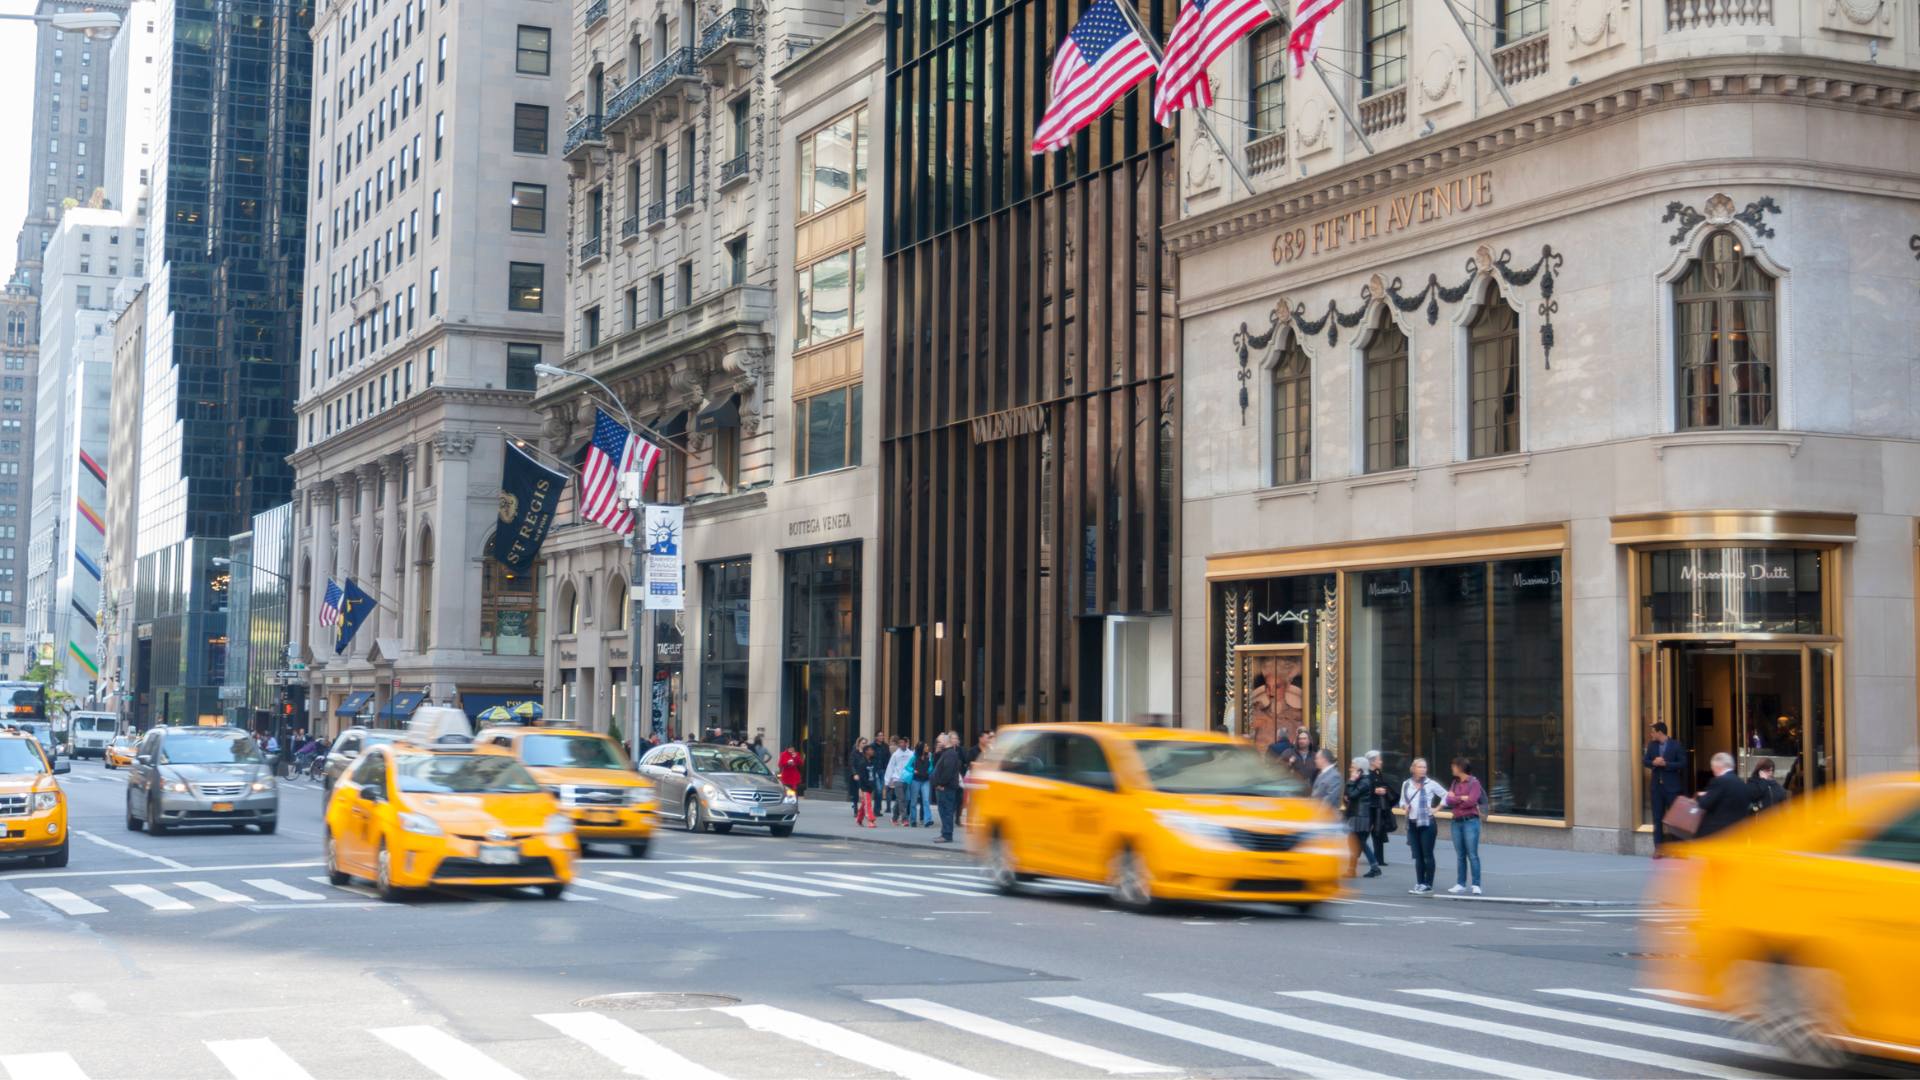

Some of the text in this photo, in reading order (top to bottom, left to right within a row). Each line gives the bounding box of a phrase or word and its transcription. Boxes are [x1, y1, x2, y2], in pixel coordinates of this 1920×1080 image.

[1272, 170, 1493, 265] 689 FIFTH AVENUE
[971, 404, 1045, 445] VALENTINO
[519, 480, 551, 539] REGIS
[788, 513, 852, 536] BOTTEGA VENETA
[1680, 564, 1791, 582] Massimo Dutti
